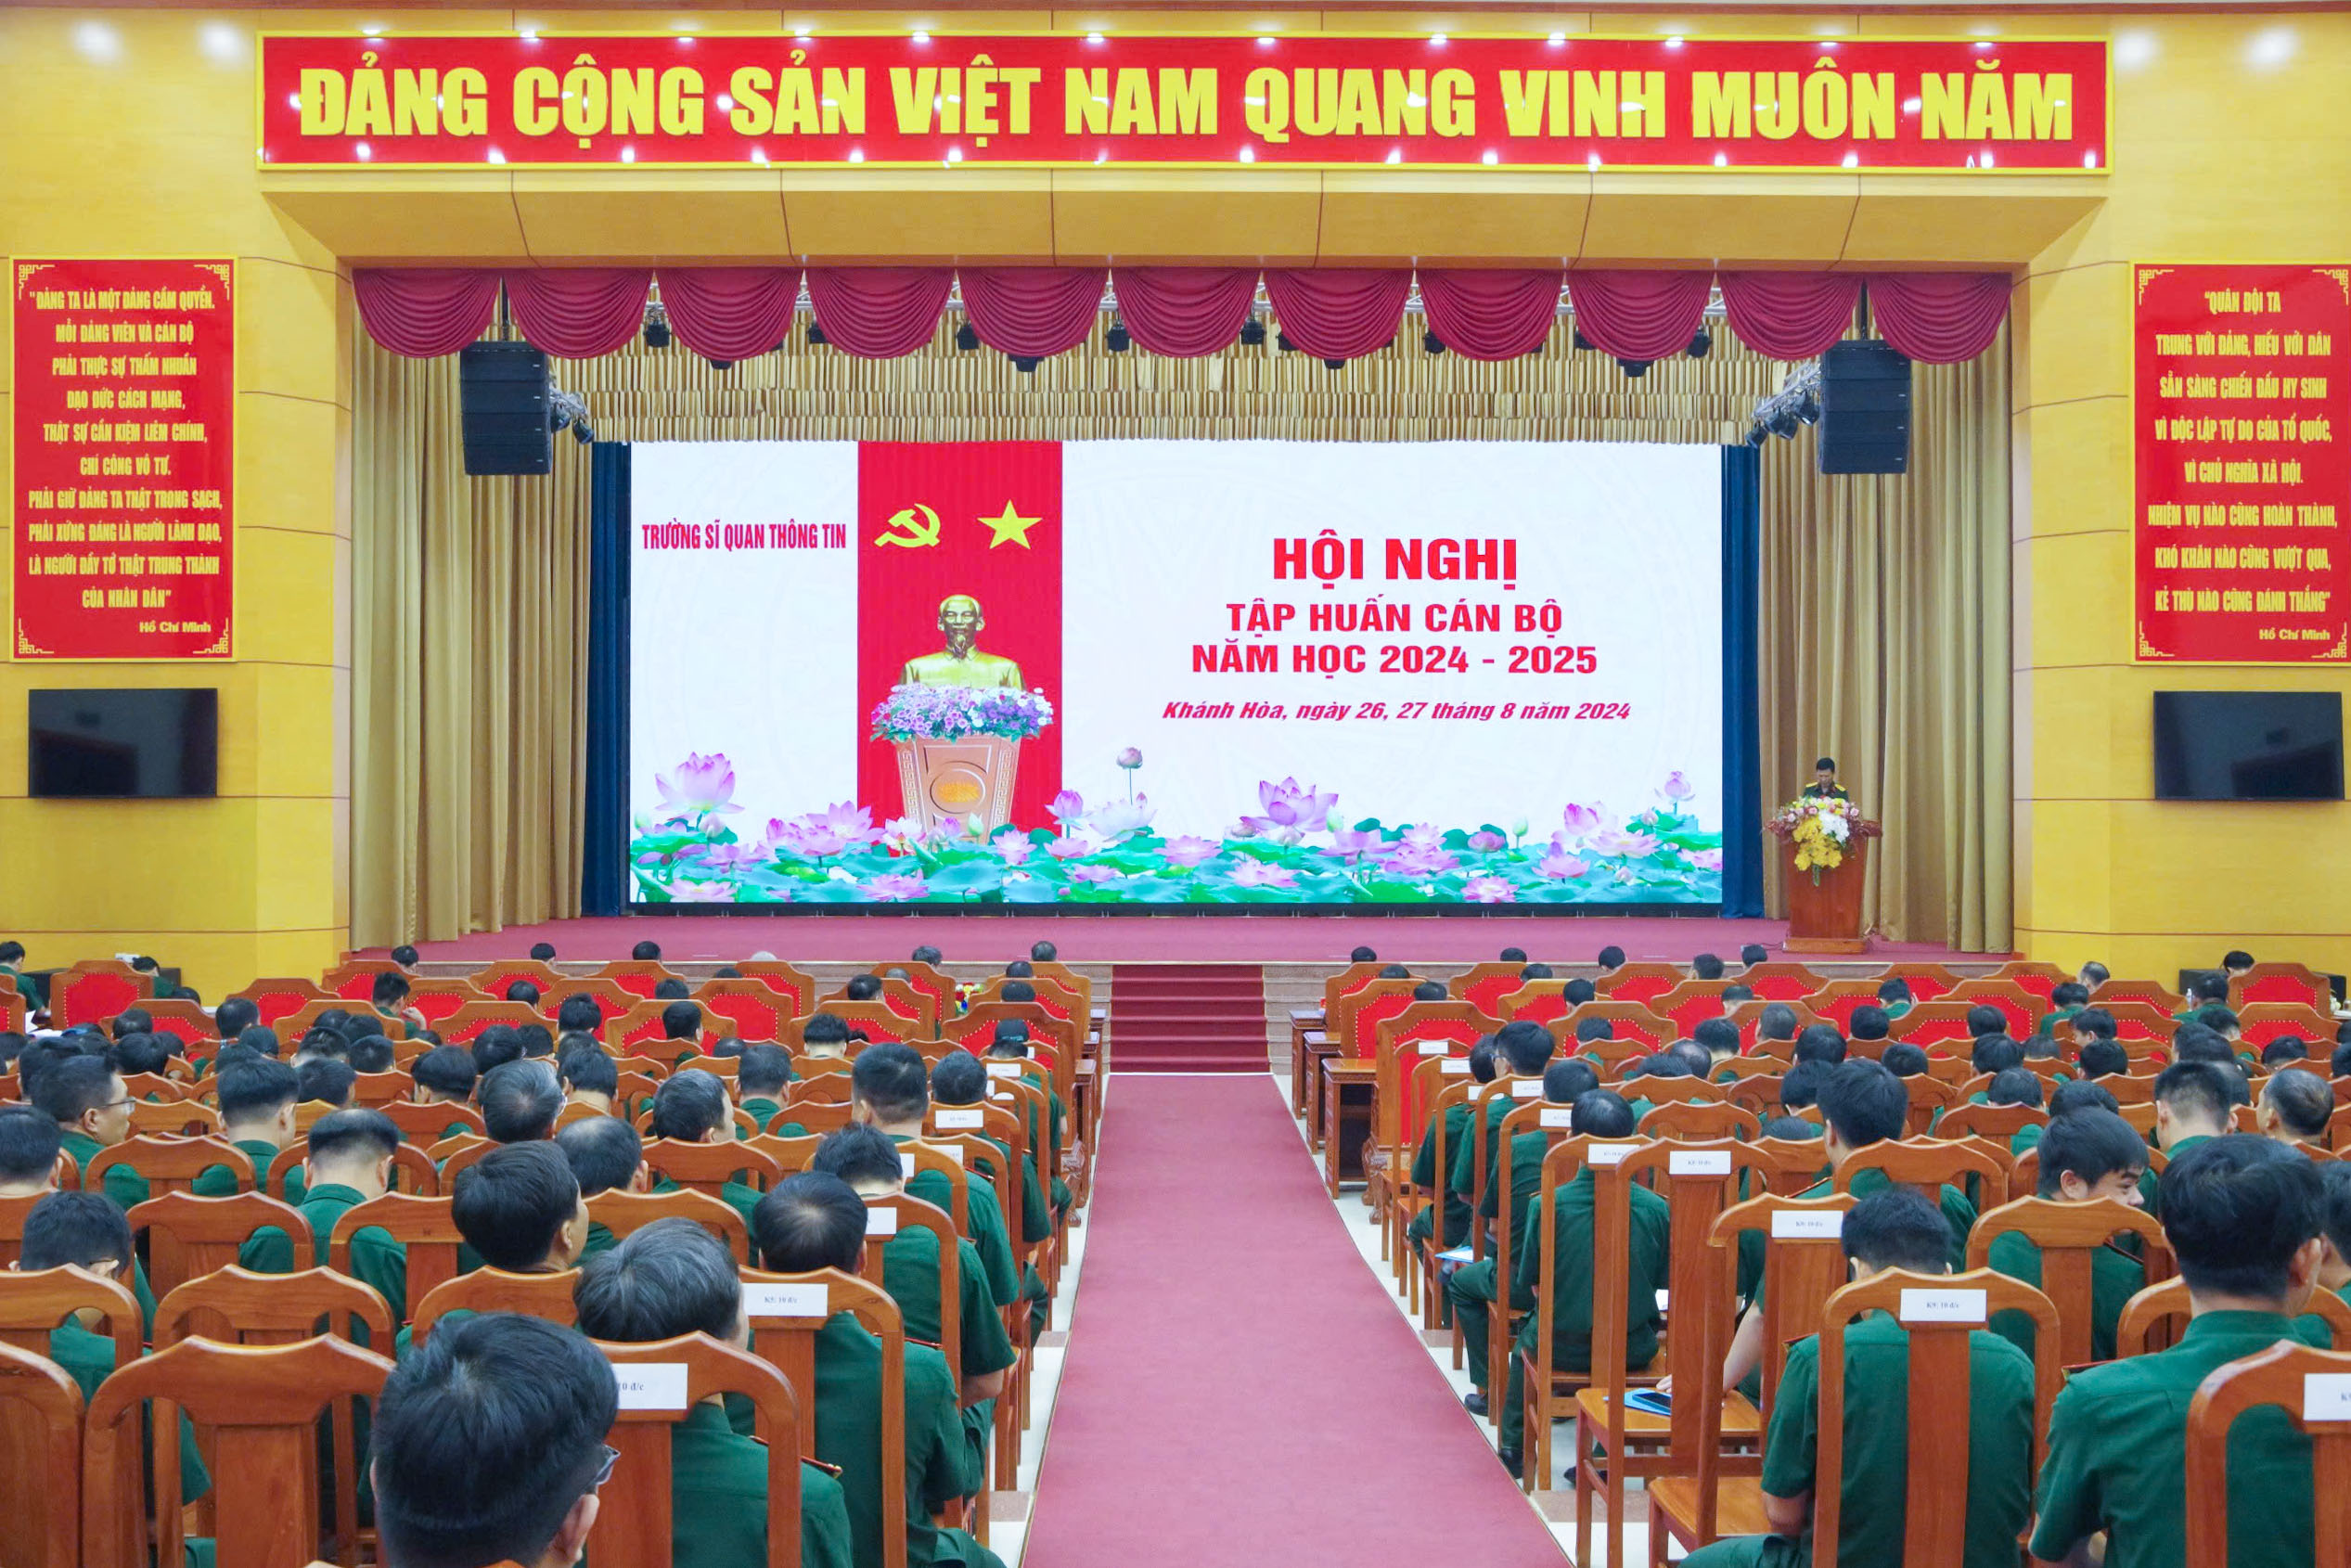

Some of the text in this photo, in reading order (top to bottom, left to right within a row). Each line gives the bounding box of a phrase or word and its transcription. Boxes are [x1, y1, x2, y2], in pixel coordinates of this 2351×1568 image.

[299, 49, 2072, 148] ĐẢNG CỘNG SẢN VIỆT NAM QUANG VINH MUÔN NĂM
[67, 291, 81, 309] TA
[84, 289, 96, 309] LÀ
[98, 288, 121, 312] MỘT
[122, 287, 151, 309] ĐẢNG
[2243, 288, 2263, 315] ĐỘI
[2267, 291, 2281, 313] TA
[80, 319, 109, 342] ĐẢNG
[111, 320, 135, 342] VIÊN
[137, 320, 152, 342] VÀ
[154, 321, 176, 342] CÁN
[179, 320, 194, 344] BỘ
[2156, 334, 2192, 355] TRUNG
[2218, 329, 2251, 357] ĐẢNG,
[2307, 331, 2331, 355] DÂN
[52, 353, 77, 376] PHẢI
[110, 355, 126, 379] SỰ
[129, 352, 159, 376] THẤM
[2186, 374, 2216, 398] SÀNG
[2220, 371, 2253, 399] CHIẾN
[2256, 371, 2280, 398] ĐẤU
[2282, 378, 2298, 398] HY
[2300, 378, 2327, 399] SINH
[67, 391, 88, 411] ĐẠO
[118, 387, 147, 408] CÁCH
[44, 420, 70, 444] THẬT
[73, 421, 88, 444] SỰ
[115, 420, 140, 444] KIỆM
[144, 420, 168, 442] LIÊM
[2155, 417, 2166, 440] VÌ
[2171, 416, 2194, 443] ĐỘC
[2197, 416, 2217, 443] LẬP
[2219, 417, 2235, 443] TỰ
[2238, 419, 2254, 441] DO
[2256, 415, 2280, 441] CỦA
[80, 454, 98, 475] CHÍ
[103, 454, 133, 475] CÔNG
[135, 454, 150, 475] VÔ
[2184, 457, 2303, 486] VÌ CHỦ NGHĨA XÃ HỘI.
[29, 487, 54, 508] PHẢI
[79, 486, 108, 508] ĐẢNG
[109, 490, 123, 508] TA
[124, 487, 151, 511] THẬT
[154, 490, 188, 508] TRONG
[2184, 505, 2201, 529] VỤ
[2203, 502, 2226, 526] NÀO
[2229, 502, 2259, 526] CŨNG
[2263, 502, 2293, 526] HOÀN
[2297, 502, 2337, 528] THÀNH,
[29, 520, 53, 542] PHẢI
[88, 521, 117, 542] ĐÁNG
[119, 521, 132, 541] LÀ
[168, 520, 195, 541] LÃNH
[642, 518, 845, 551] TRƯỜNG SĨ QUAN THÔNG TIN
[29, 554, 42, 574] LÀ
[119, 554, 146, 576] THẬT
[148, 557, 183, 574] TRUNG
[185, 554, 219, 574] THÀNH
[1274, 529, 1516, 590] HỘI NGHỊ
[2155, 544, 2331, 572] KHÓ KHĂN NÀO CŨNG VƯỢT QUA,
[83, 586, 104, 608] CỦA
[109, 586, 137, 608] NHÂN
[2155, 585, 2169, 610] KẺ
[2172, 587, 2194, 611] THÙ
[2197, 588, 2219, 611] NÀO
[2223, 588, 2253, 611] CŨNG
[2256, 588, 2286, 611] ĐÁNH
[139, 620, 211, 633] Hồ Chí Minh
[1227, 594, 1561, 638] TẬP HUẤN CÁN BỘ
[2259, 627, 2331, 640] Hồ Chí Minh
[1193, 638, 1278, 672] NĂM
[1293, 645, 1366, 678] HỌC
[1380, 646, 1469, 673] 2024
[1509, 646, 1597, 674] 2025
[1163, 701, 1630, 721] Khánh Hòa, ngày 26, 27 tháng 8 năm 2024
